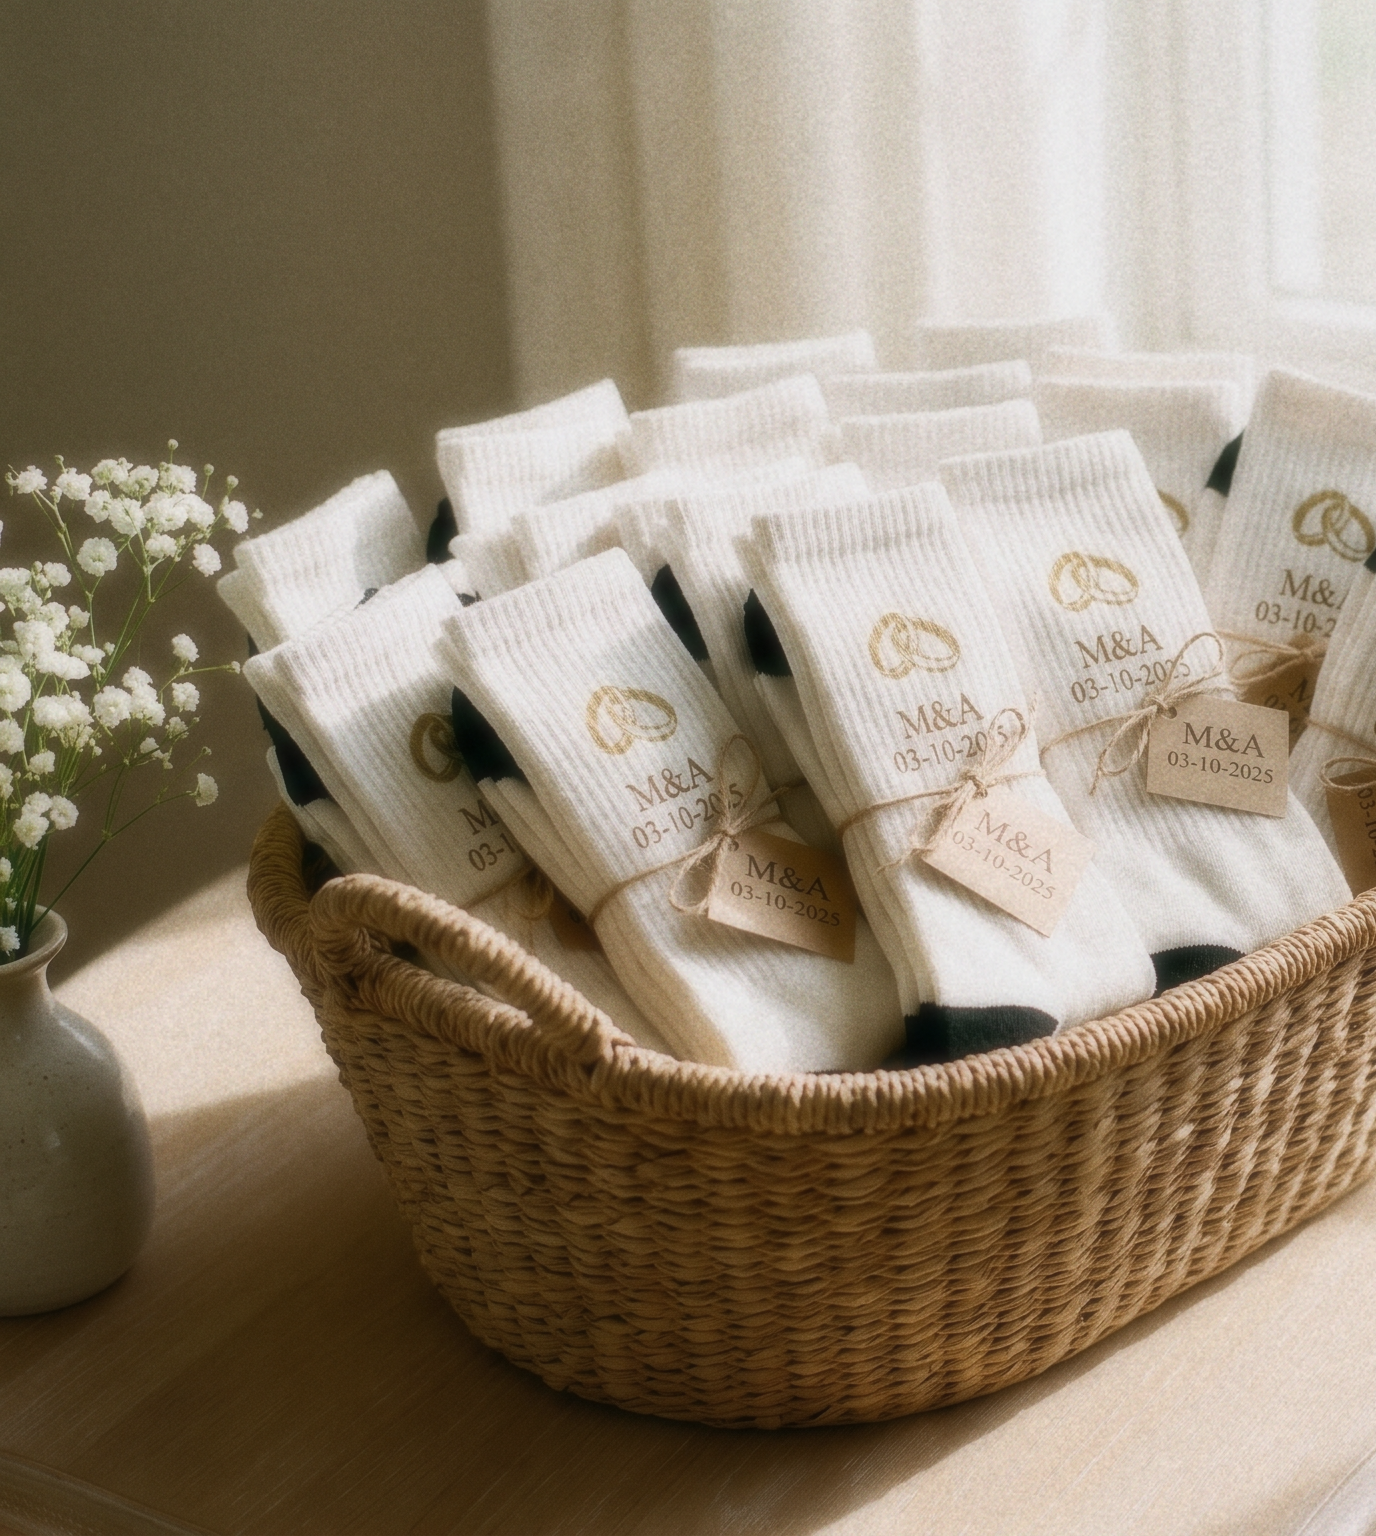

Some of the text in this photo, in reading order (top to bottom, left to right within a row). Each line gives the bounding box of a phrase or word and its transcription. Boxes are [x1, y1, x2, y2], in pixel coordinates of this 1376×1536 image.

[1279, 569, 1349, 610] M&
[1074, 624, 1164, 669] M&A
[896, 692, 984, 739] M&A
[1182, 721, 1265, 758] M&A
[893, 725, 1008, 774] 03-10-205
[1167, 751, 1274, 784] 03-10-2025
[625, 757, 714, 812] M&A
[632, 782, 744, 849] 03-10-205
[952, 830, 1056, 900] 03-10-2025
[974, 809, 1053, 875] M&A
[745, 853, 831, 902] M&A
[730, 881, 840, 926] 03-10-2025
